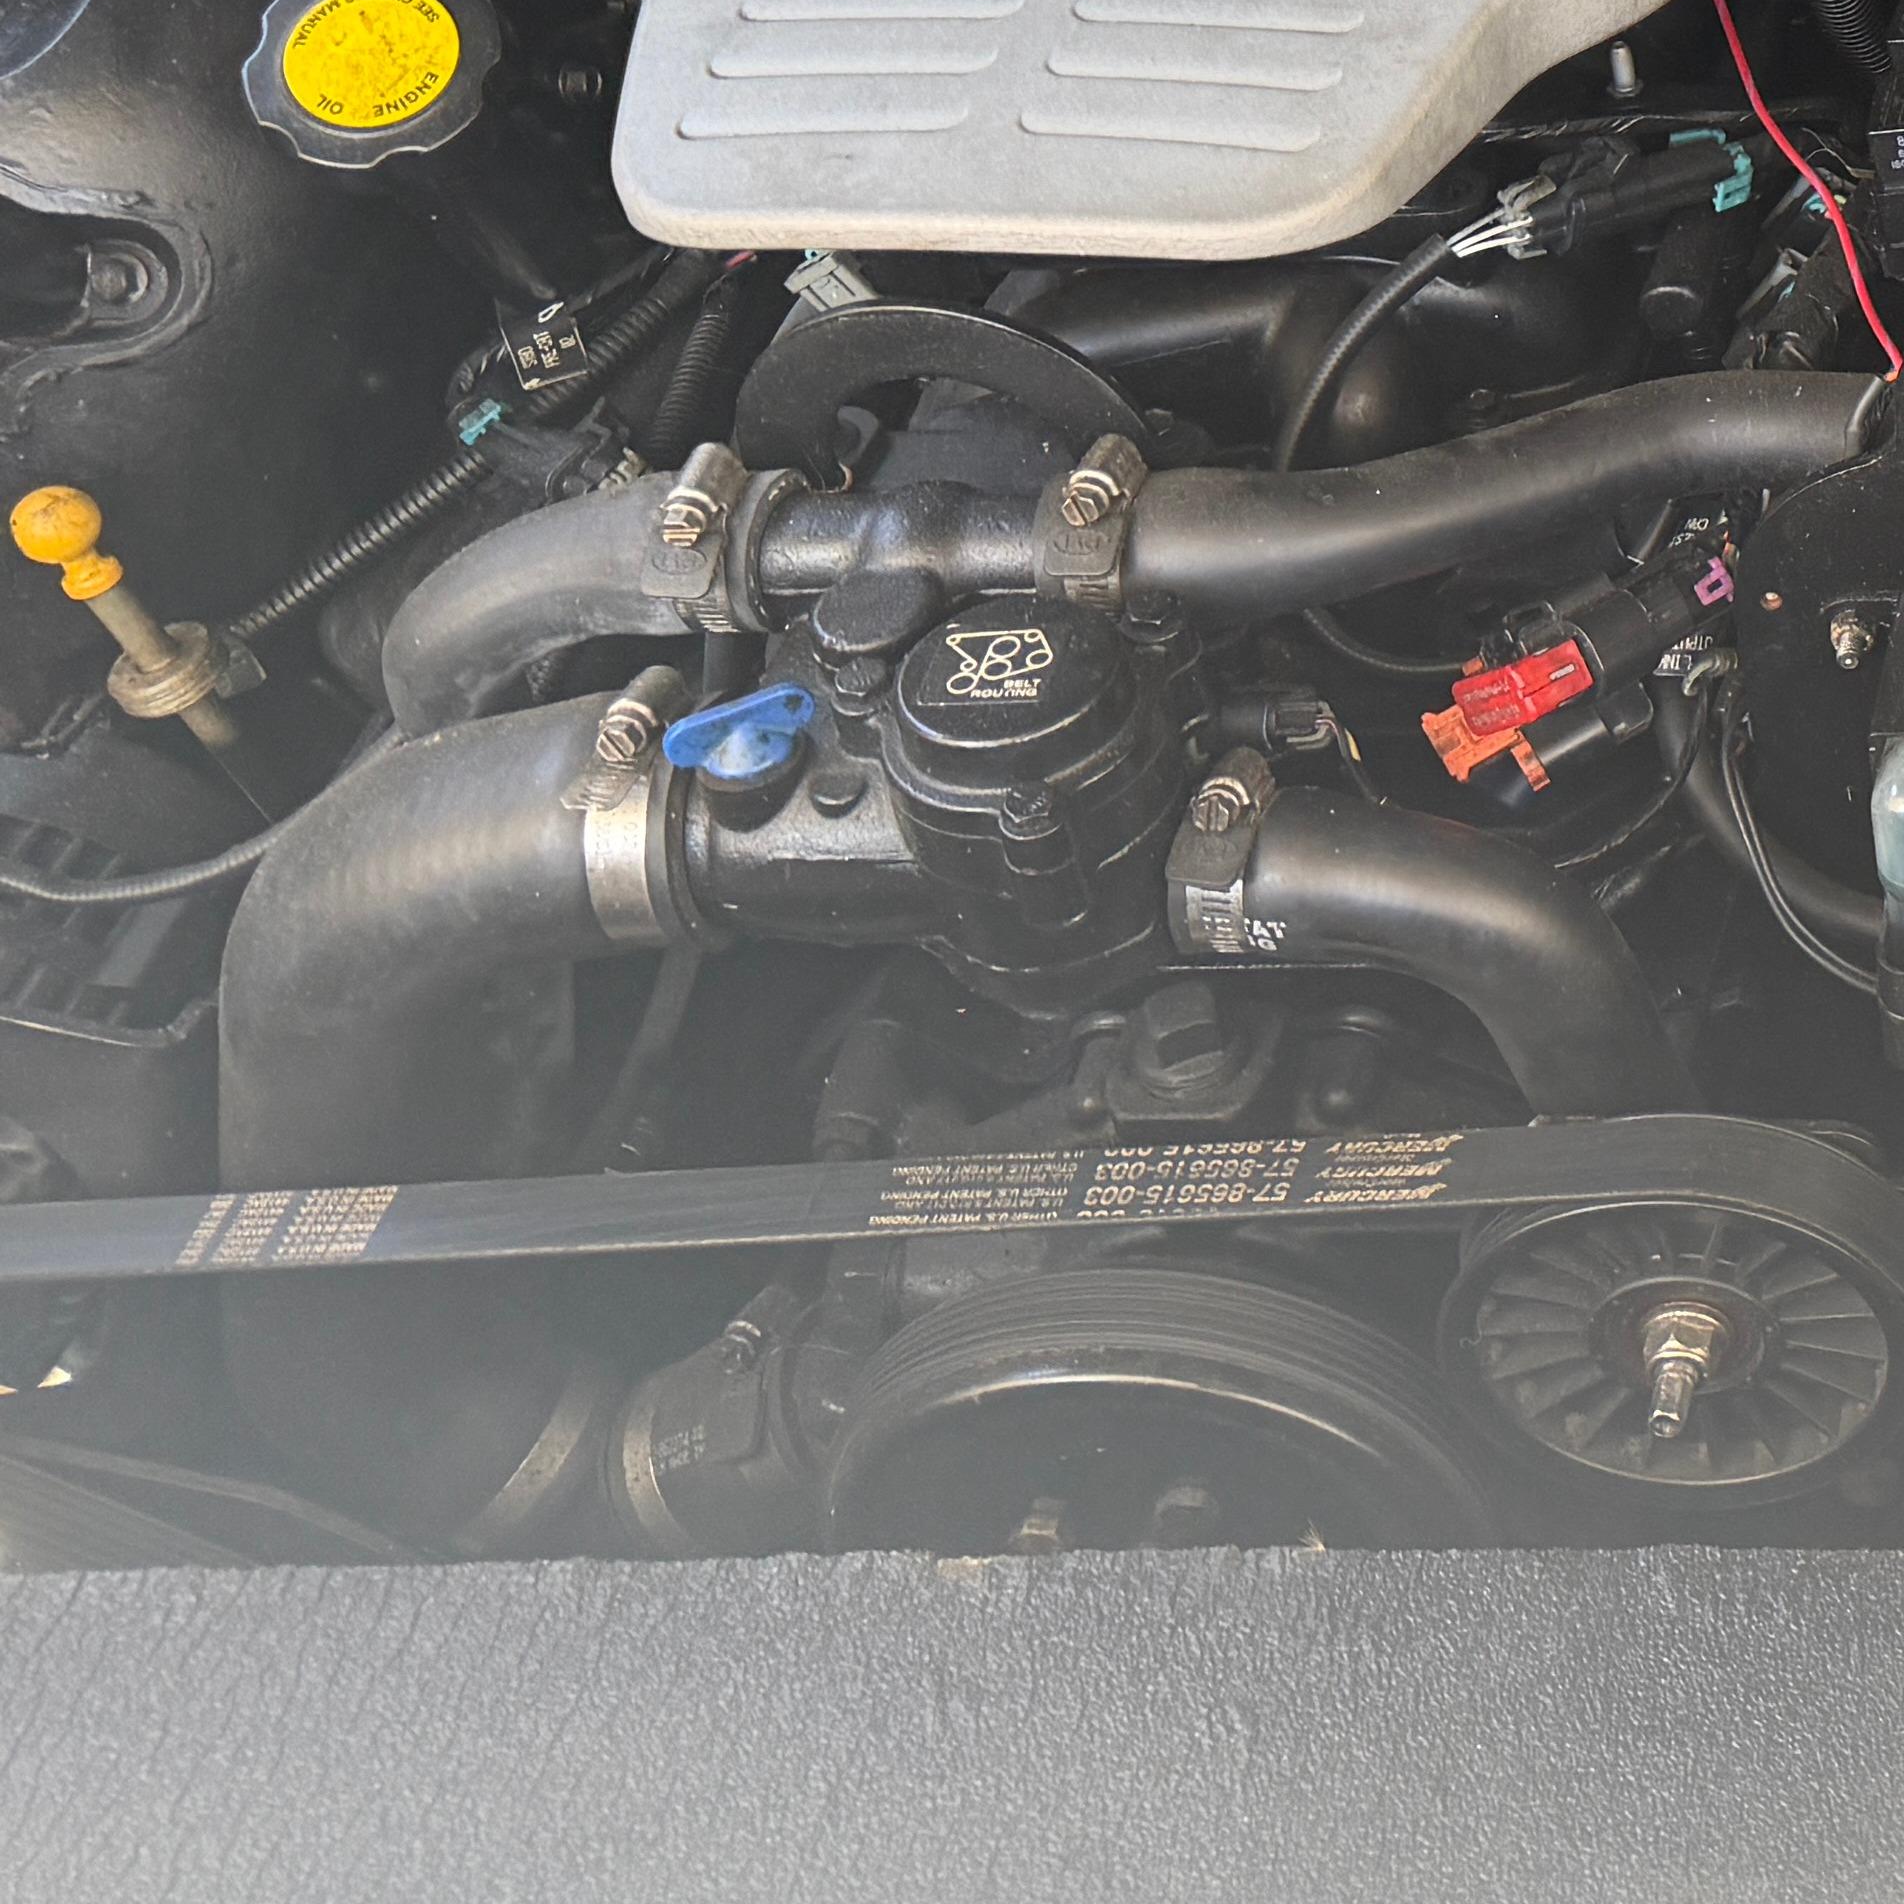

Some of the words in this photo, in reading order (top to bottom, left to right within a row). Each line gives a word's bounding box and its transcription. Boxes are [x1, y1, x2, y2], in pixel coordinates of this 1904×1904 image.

[414, 0, 440, 23] SEE
[292, 0, 341, 48] MANUAL
[316, 94, 344, 115] OIL
[373, 71, 439, 118] ENGINE
[970, 688, 1037, 698] ROUTING
[1004, 678, 1041, 688] BELT
[943, 1189, 992, 1200] PATENT
[1083, 1182, 1291, 1207] 57-865615-003
[1304, 1182, 1447, 1203] MERCURY
[930, 1212, 981, 1224] PATENT
